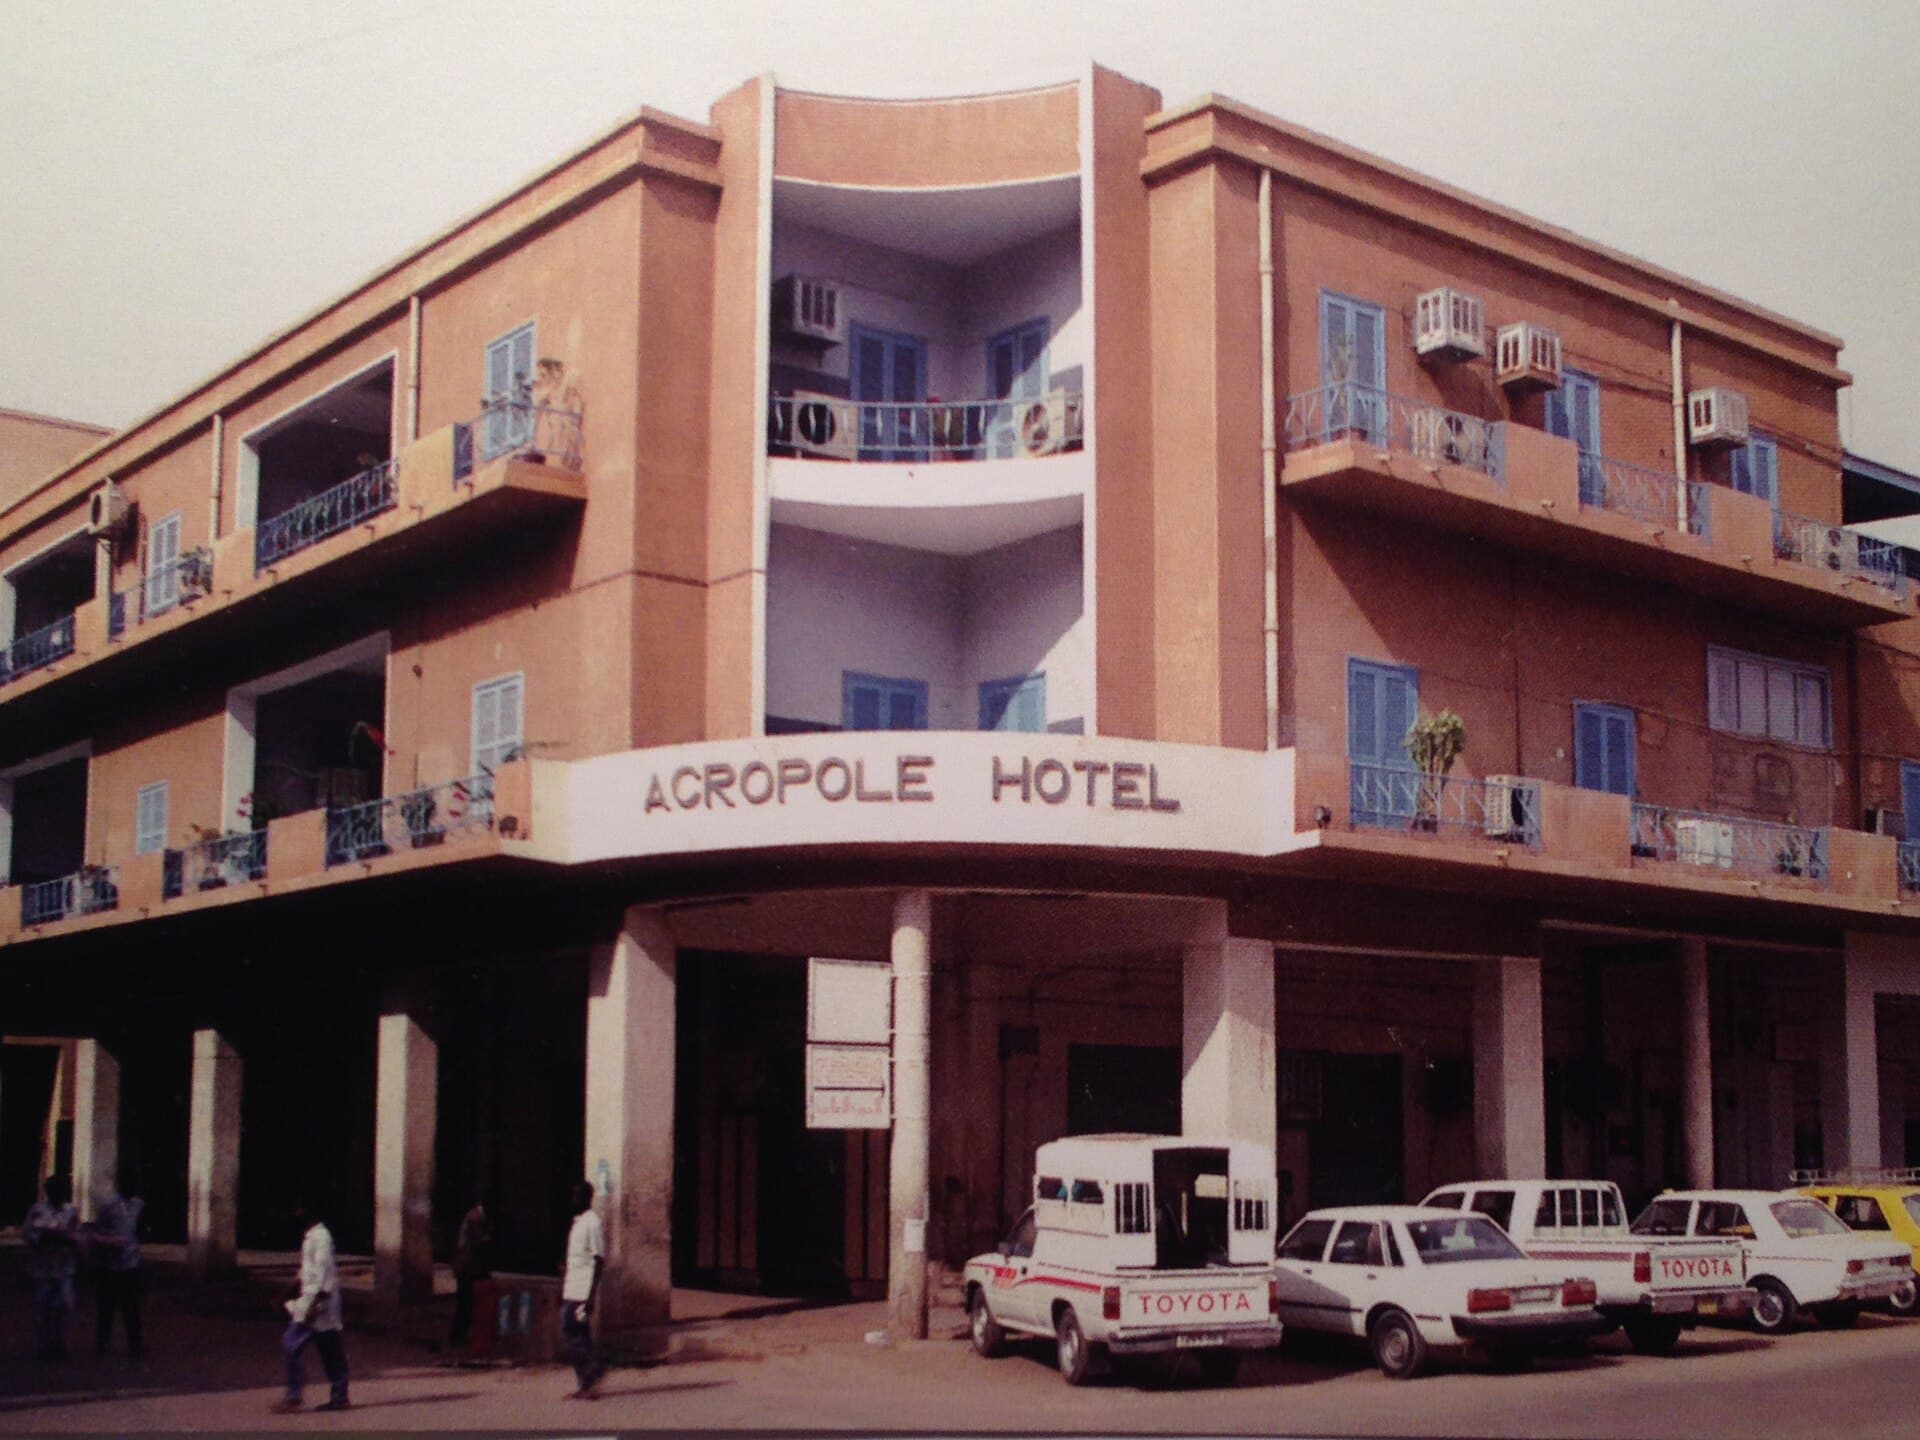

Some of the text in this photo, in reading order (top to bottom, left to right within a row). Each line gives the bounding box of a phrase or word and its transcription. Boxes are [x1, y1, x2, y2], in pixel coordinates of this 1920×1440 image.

[644, 755, 1182, 814] ACROPOLE HOTEL
[1661, 1258, 1732, 1278] TOYOTA
[1139, 1293, 1250, 1315] TOYOTA
